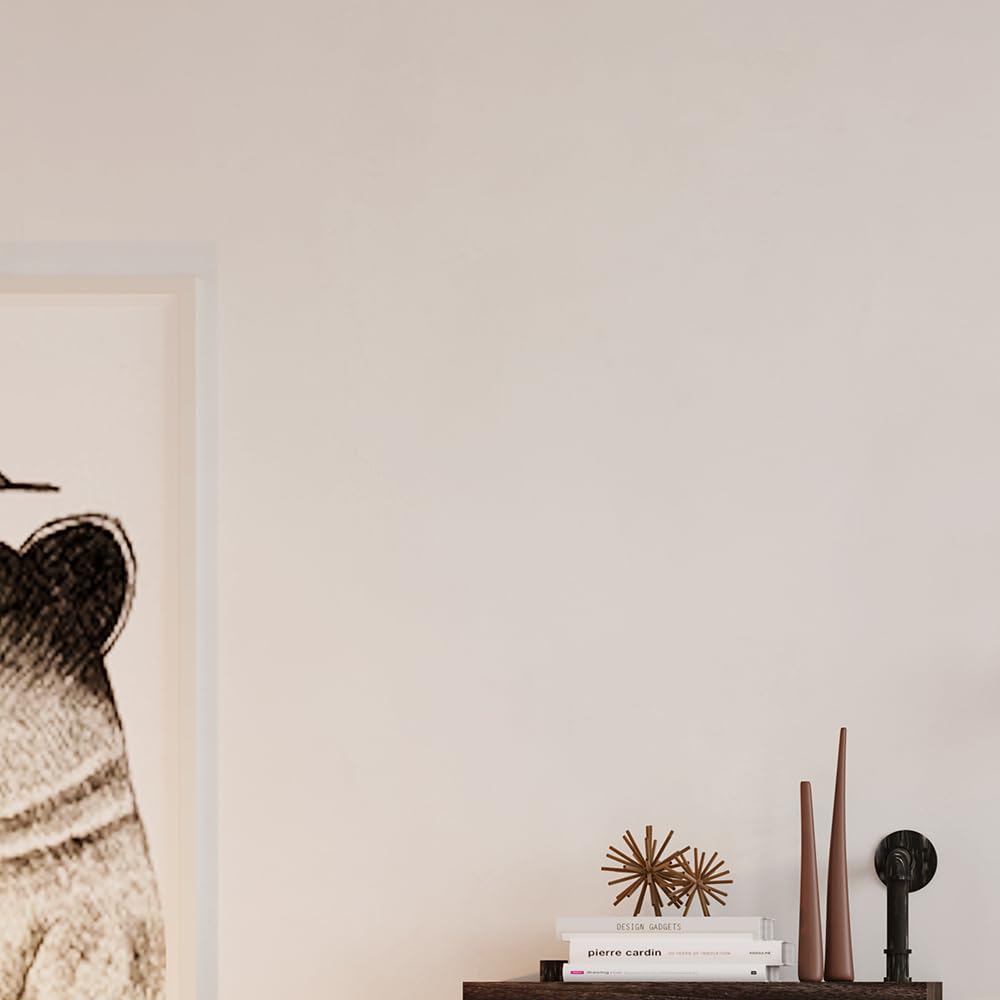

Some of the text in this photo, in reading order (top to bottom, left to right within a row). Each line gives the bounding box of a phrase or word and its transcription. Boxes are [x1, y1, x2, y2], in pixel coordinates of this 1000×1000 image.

[616, 923, 682, 931] DESIGN GADGETS
[588, 948, 622, 959] pierre
[625, 948, 662, 957] cardin
